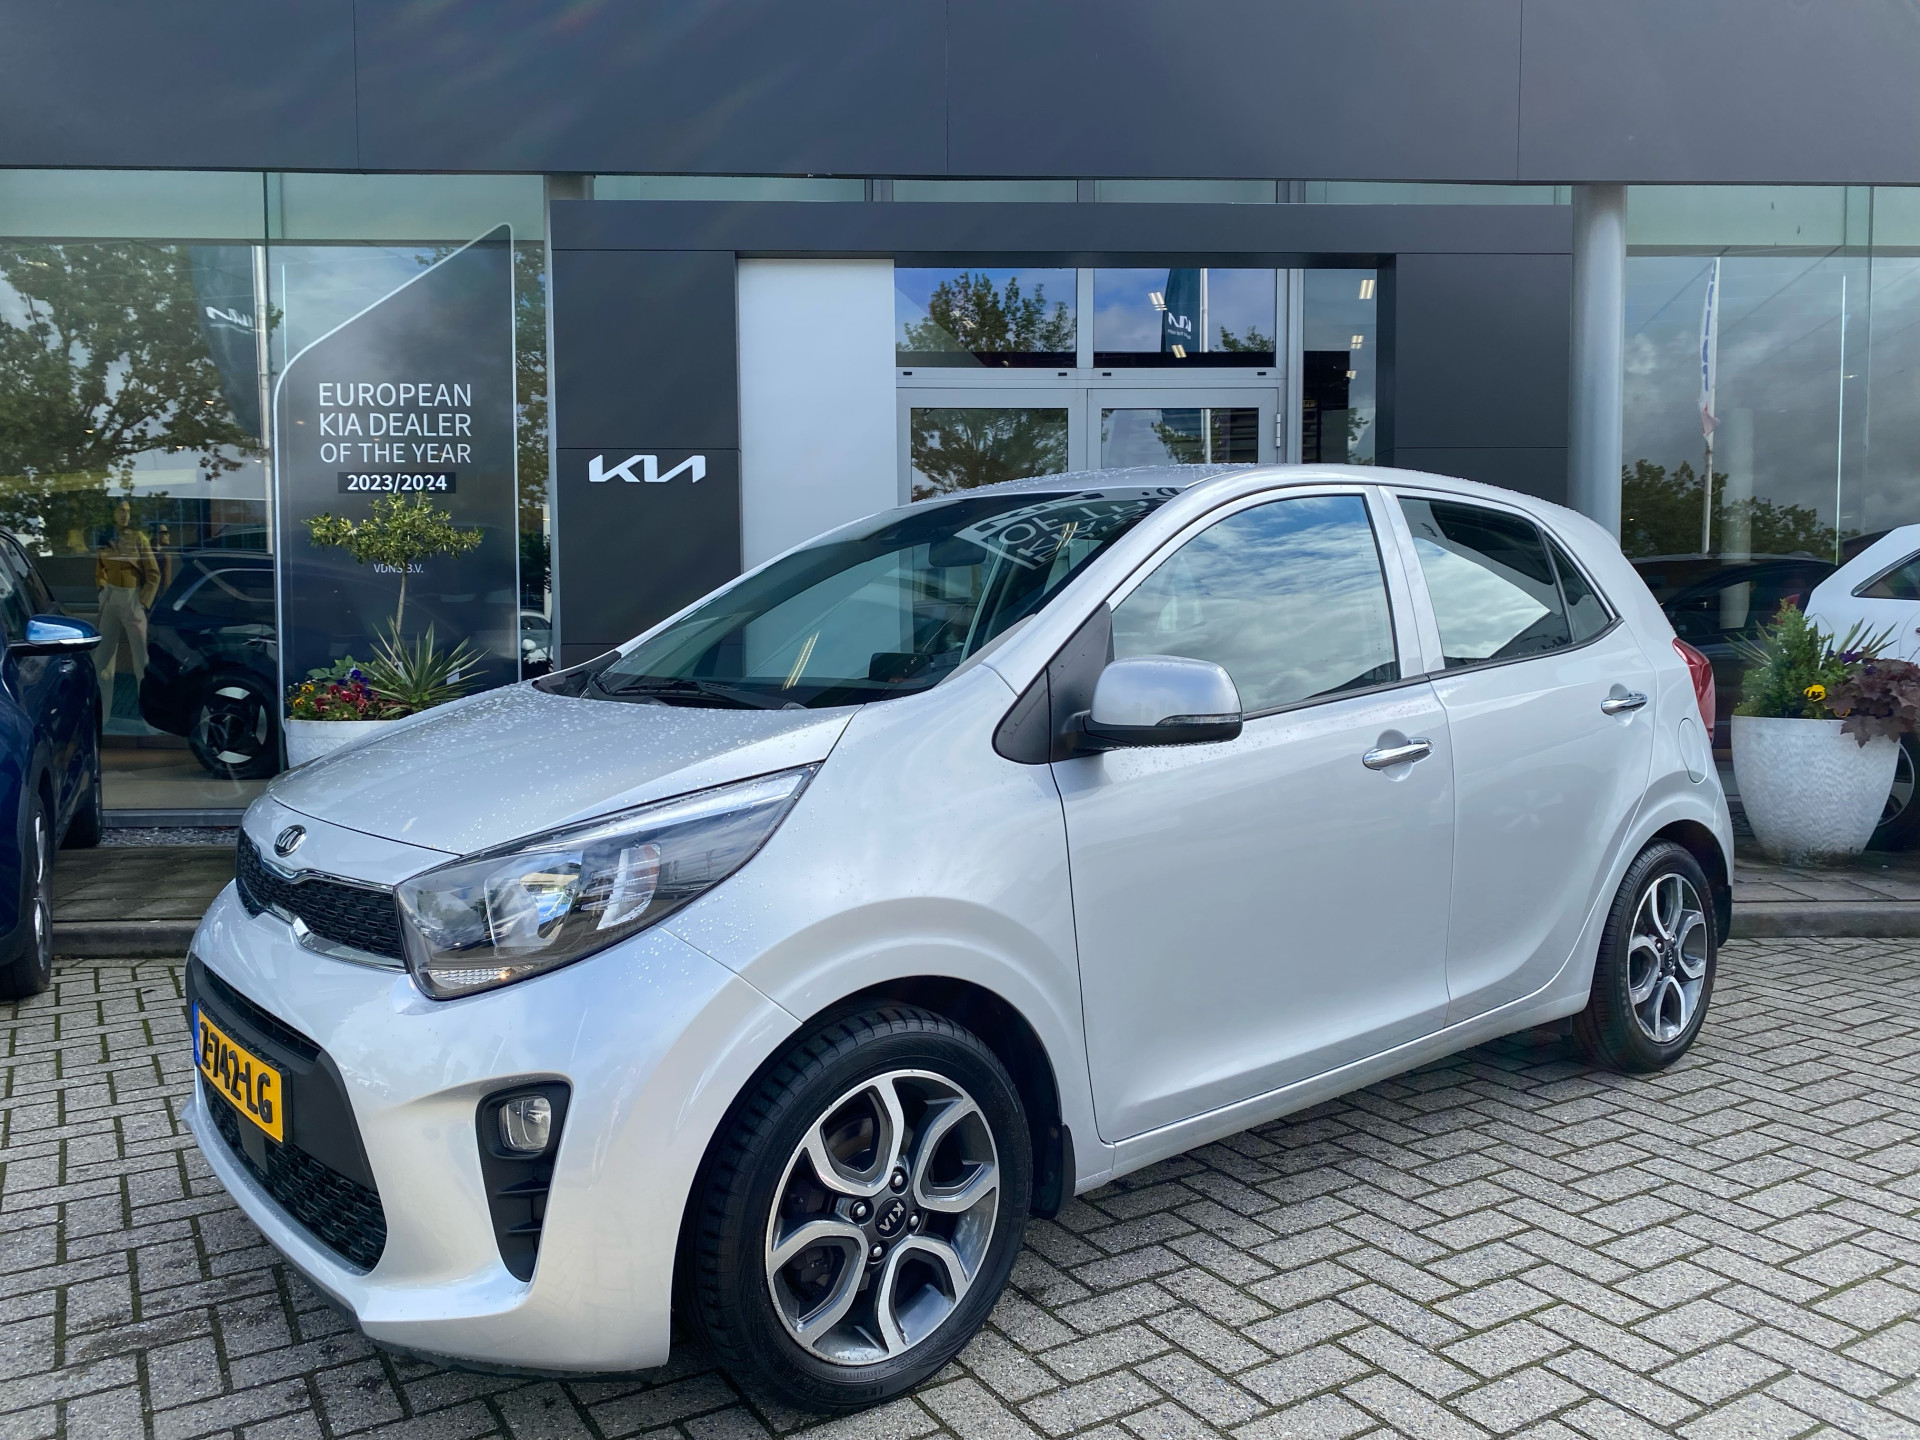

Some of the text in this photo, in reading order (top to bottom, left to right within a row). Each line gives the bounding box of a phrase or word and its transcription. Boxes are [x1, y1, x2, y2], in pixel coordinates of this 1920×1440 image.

[319, 382, 471, 407] EUROPEAN
[319, 413, 472, 437] KIA DEALER
[320, 442, 472, 464] OF THE YEAR
[588, 454, 706, 484] KIA
[347, 473, 448, 494] 2023/2024
[879, 1201, 905, 1231] KIA
